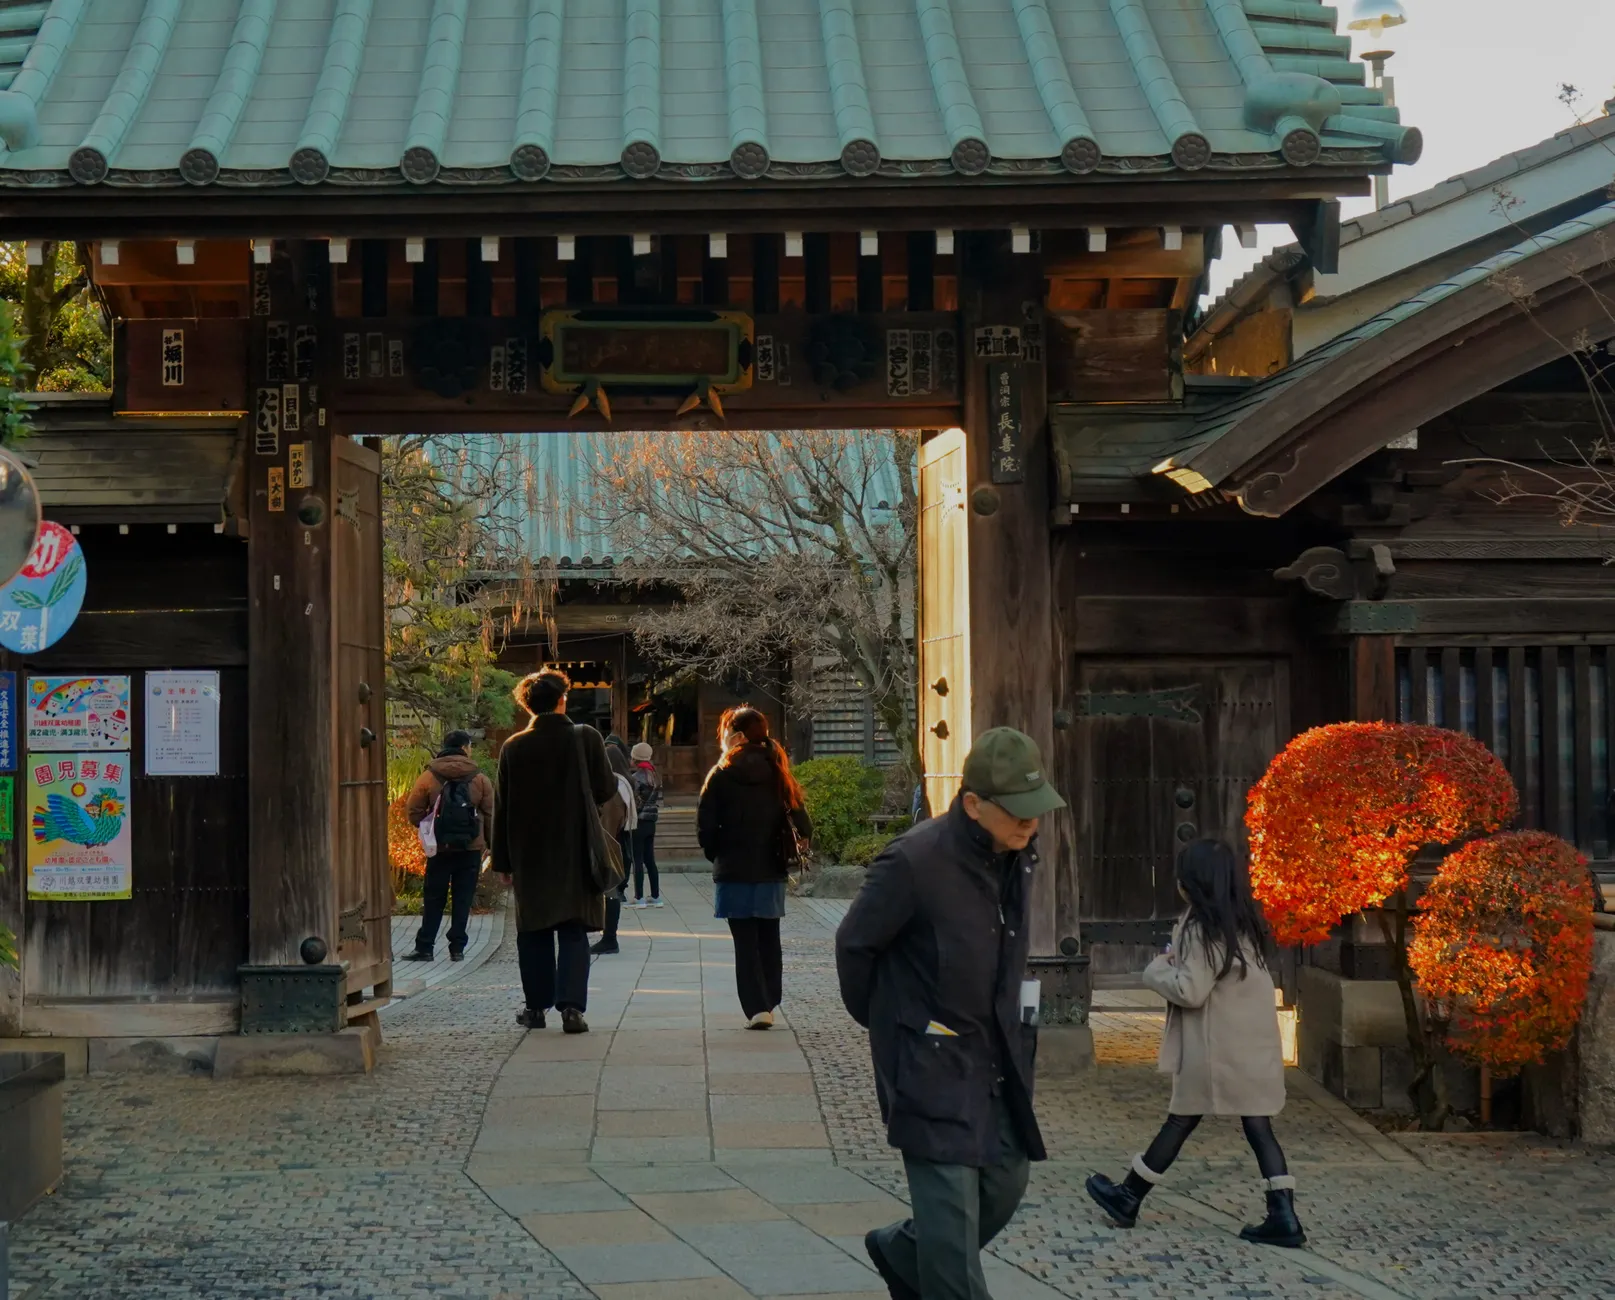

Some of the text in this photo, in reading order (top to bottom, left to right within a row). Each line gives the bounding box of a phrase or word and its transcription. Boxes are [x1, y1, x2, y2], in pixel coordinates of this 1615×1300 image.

[164, 345, 182, 384] 堀川
[257, 390, 277, 453] たい三
[34, 760, 123, 786] 園児募集
